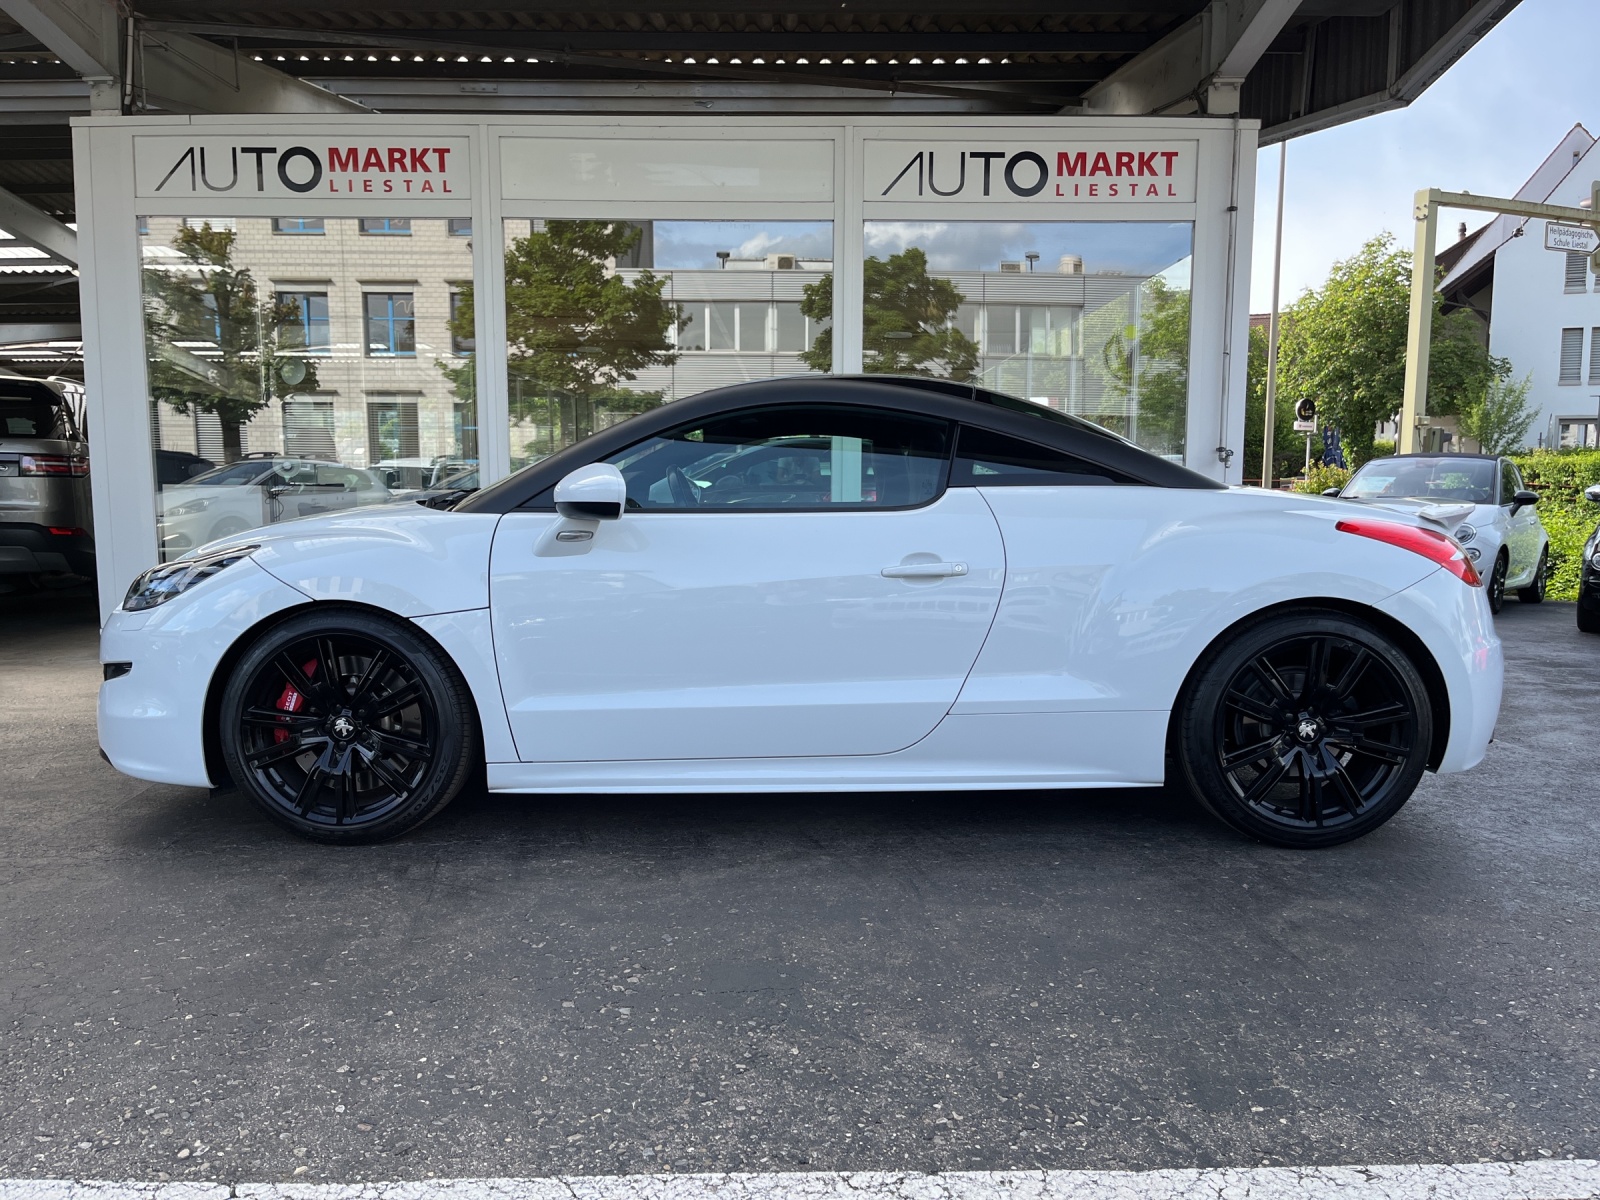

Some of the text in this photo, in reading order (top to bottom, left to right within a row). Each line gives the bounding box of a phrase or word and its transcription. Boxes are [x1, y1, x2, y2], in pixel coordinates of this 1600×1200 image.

[154, 146, 451, 193] AUTO MARKT
[881, 150, 1179, 198] AUTO MARKT
[329, 179, 452, 193] LIESTAL
[1055, 183, 1177, 197] LIESTAL
[1549, 226, 1593, 240] Heilpädagogische
[1553, 238, 1588, 249] Schule Liestal
